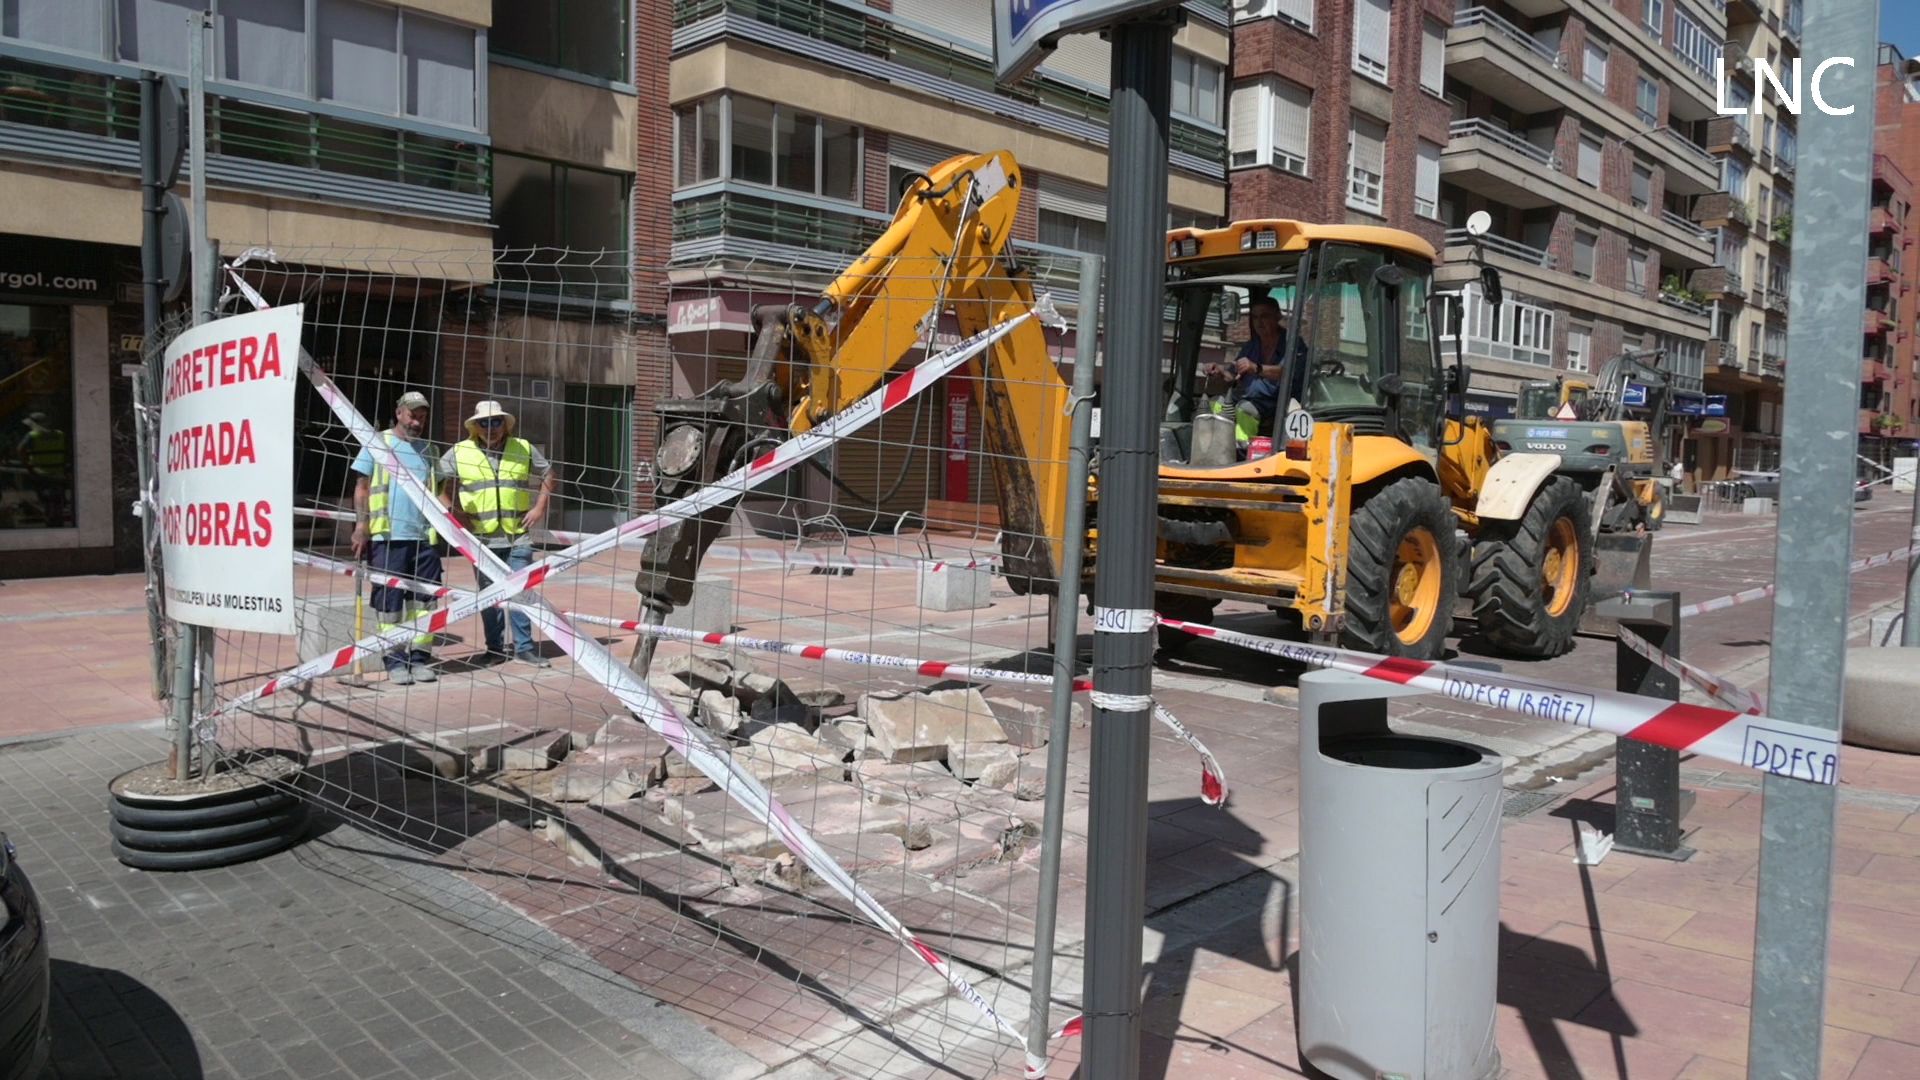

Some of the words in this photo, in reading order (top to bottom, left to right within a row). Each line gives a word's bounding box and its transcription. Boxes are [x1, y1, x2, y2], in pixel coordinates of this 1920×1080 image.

[0, 272, 98, 291] rgol.com
[165, 332, 281, 405] CARRETERA
[1290, 413, 1309, 438] 40
[167, 418, 256, 473] CORTADA
[1526, 442, 1567, 451] VOLVO
[162, 504, 182, 546] POR
[185, 500, 272, 548] OBRAS
[206, 591, 222, 608] LAS
[223, 594, 283, 613] MOLESTIAS
